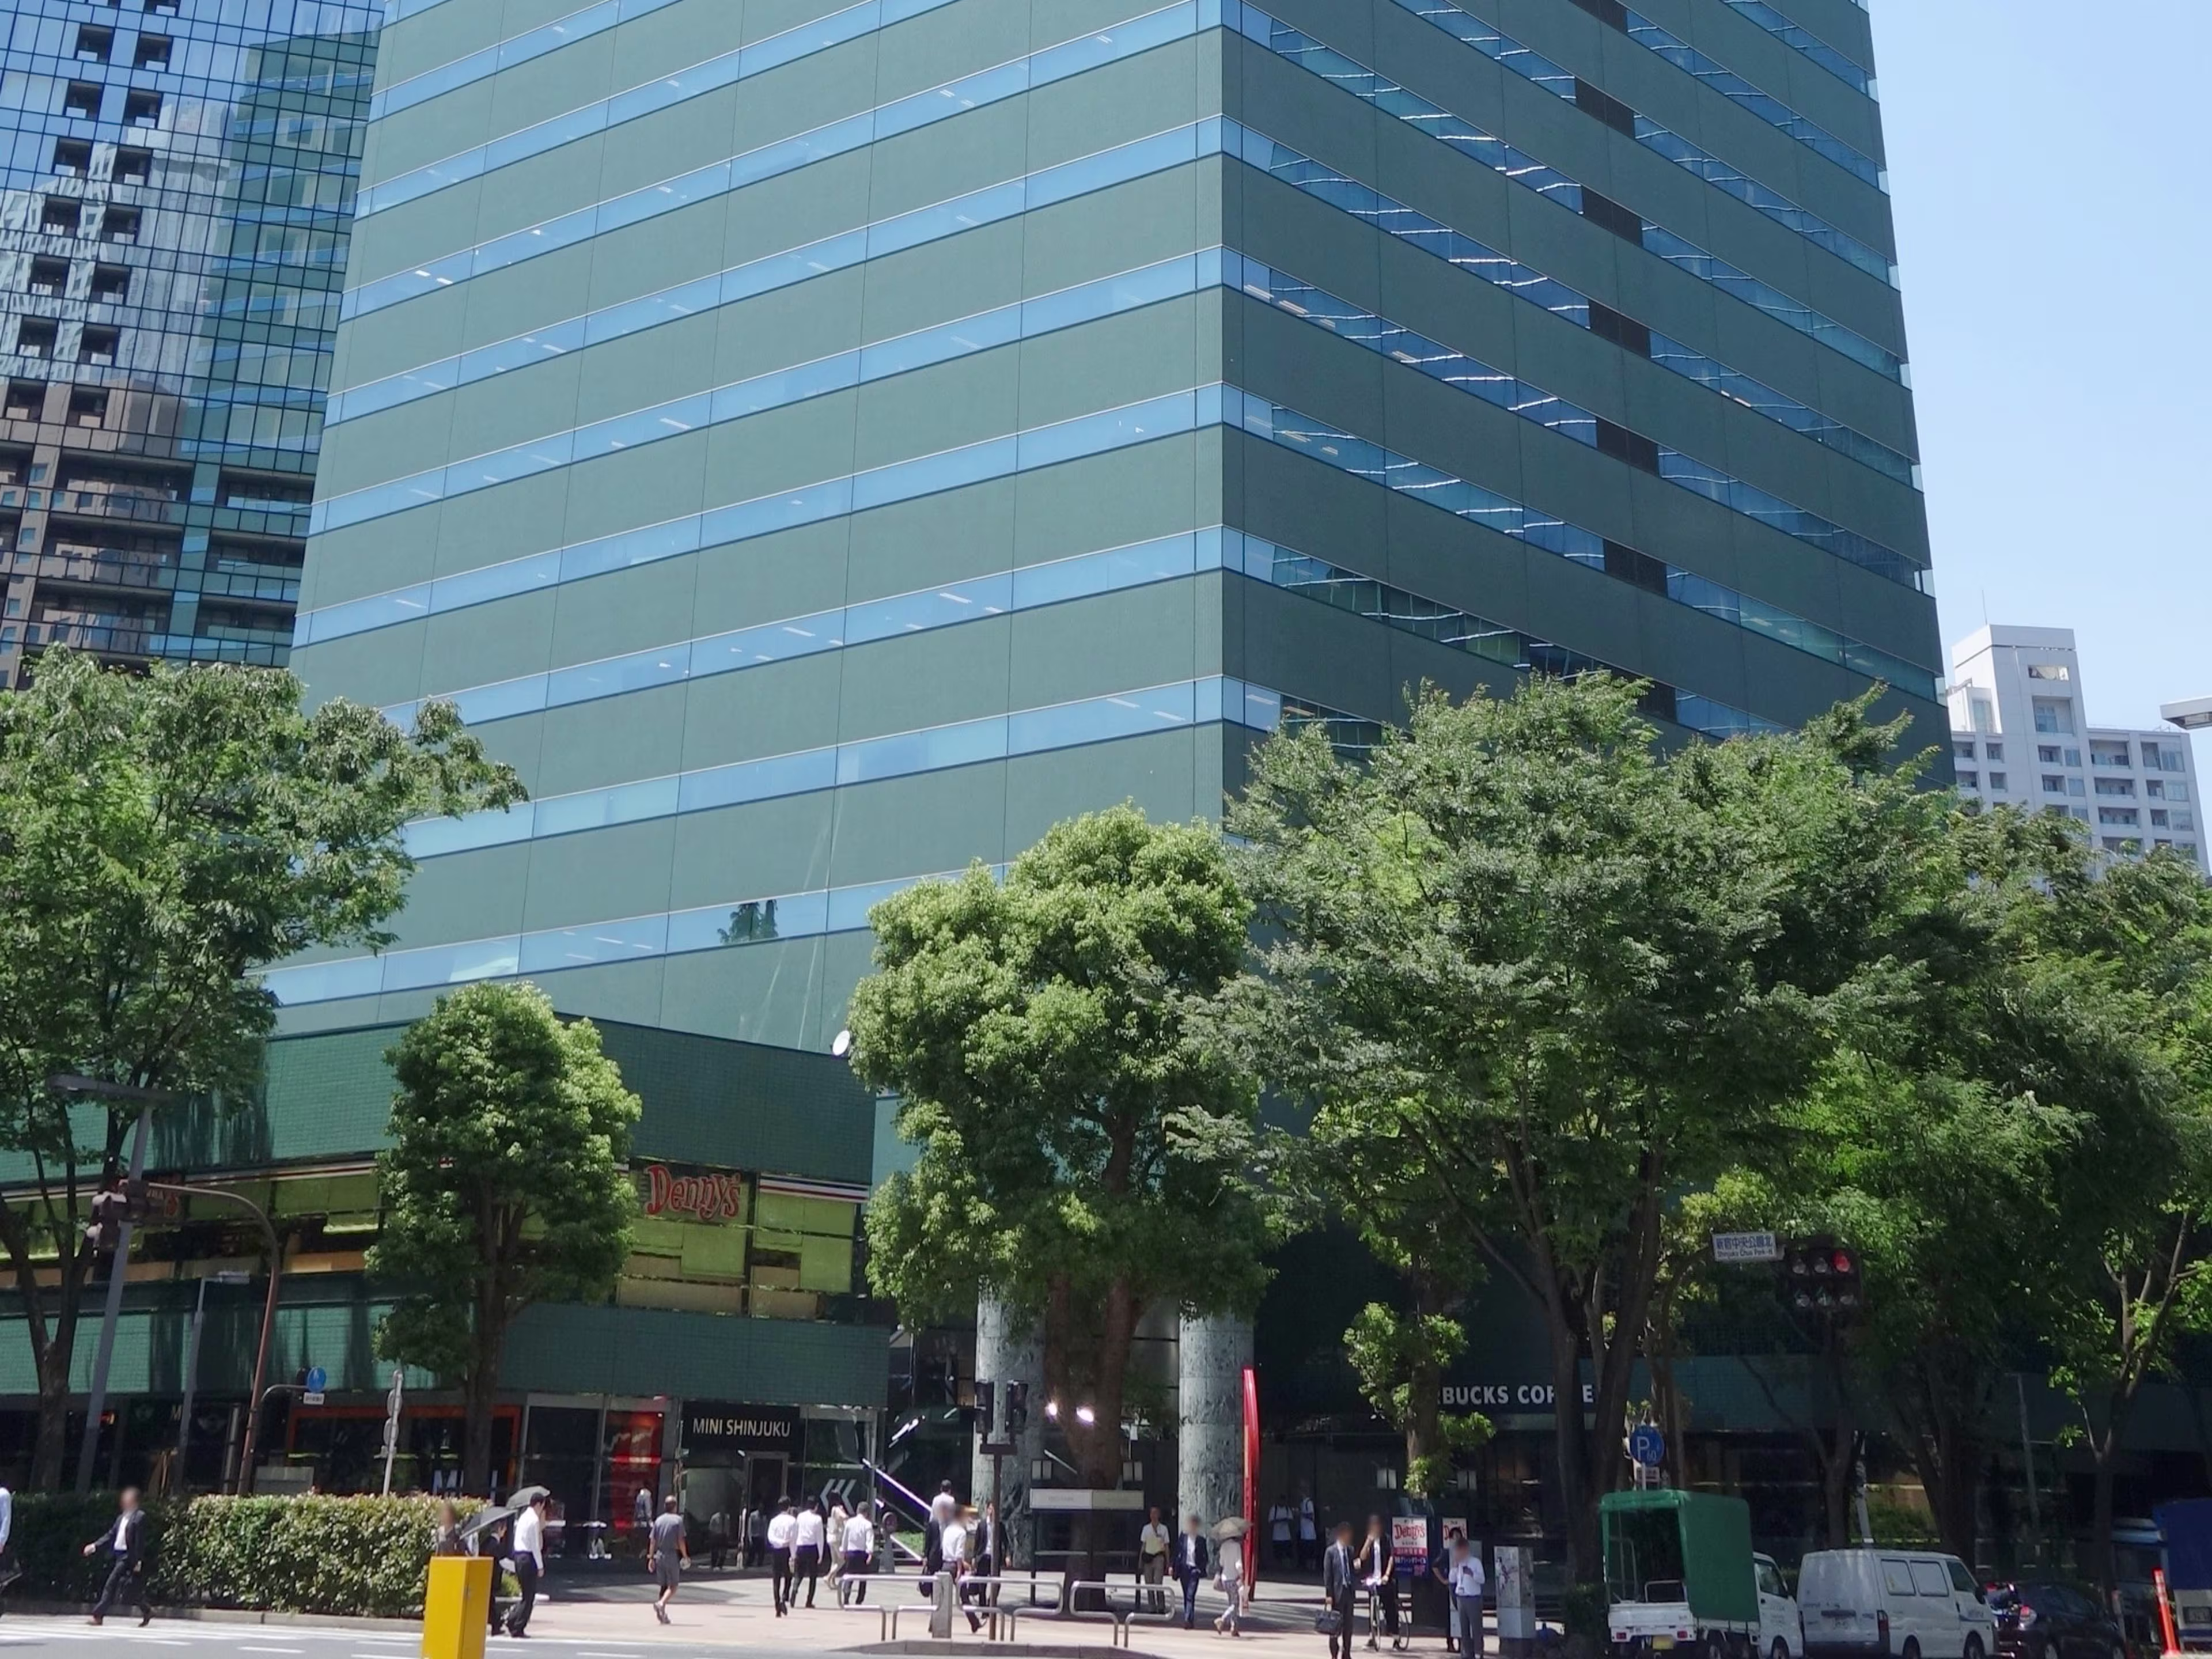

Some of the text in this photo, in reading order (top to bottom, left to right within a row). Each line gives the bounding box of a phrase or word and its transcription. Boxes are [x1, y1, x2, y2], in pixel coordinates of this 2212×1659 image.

[645, 1165, 741, 1221] Denny's
[1438, 1385, 1509, 1404] BUCKS
[693, 1418, 790, 1437] MINI SHINJUKU
[1637, 1436, 1650, 1461] P
[1394, 1524, 1425, 1540] Denny's
